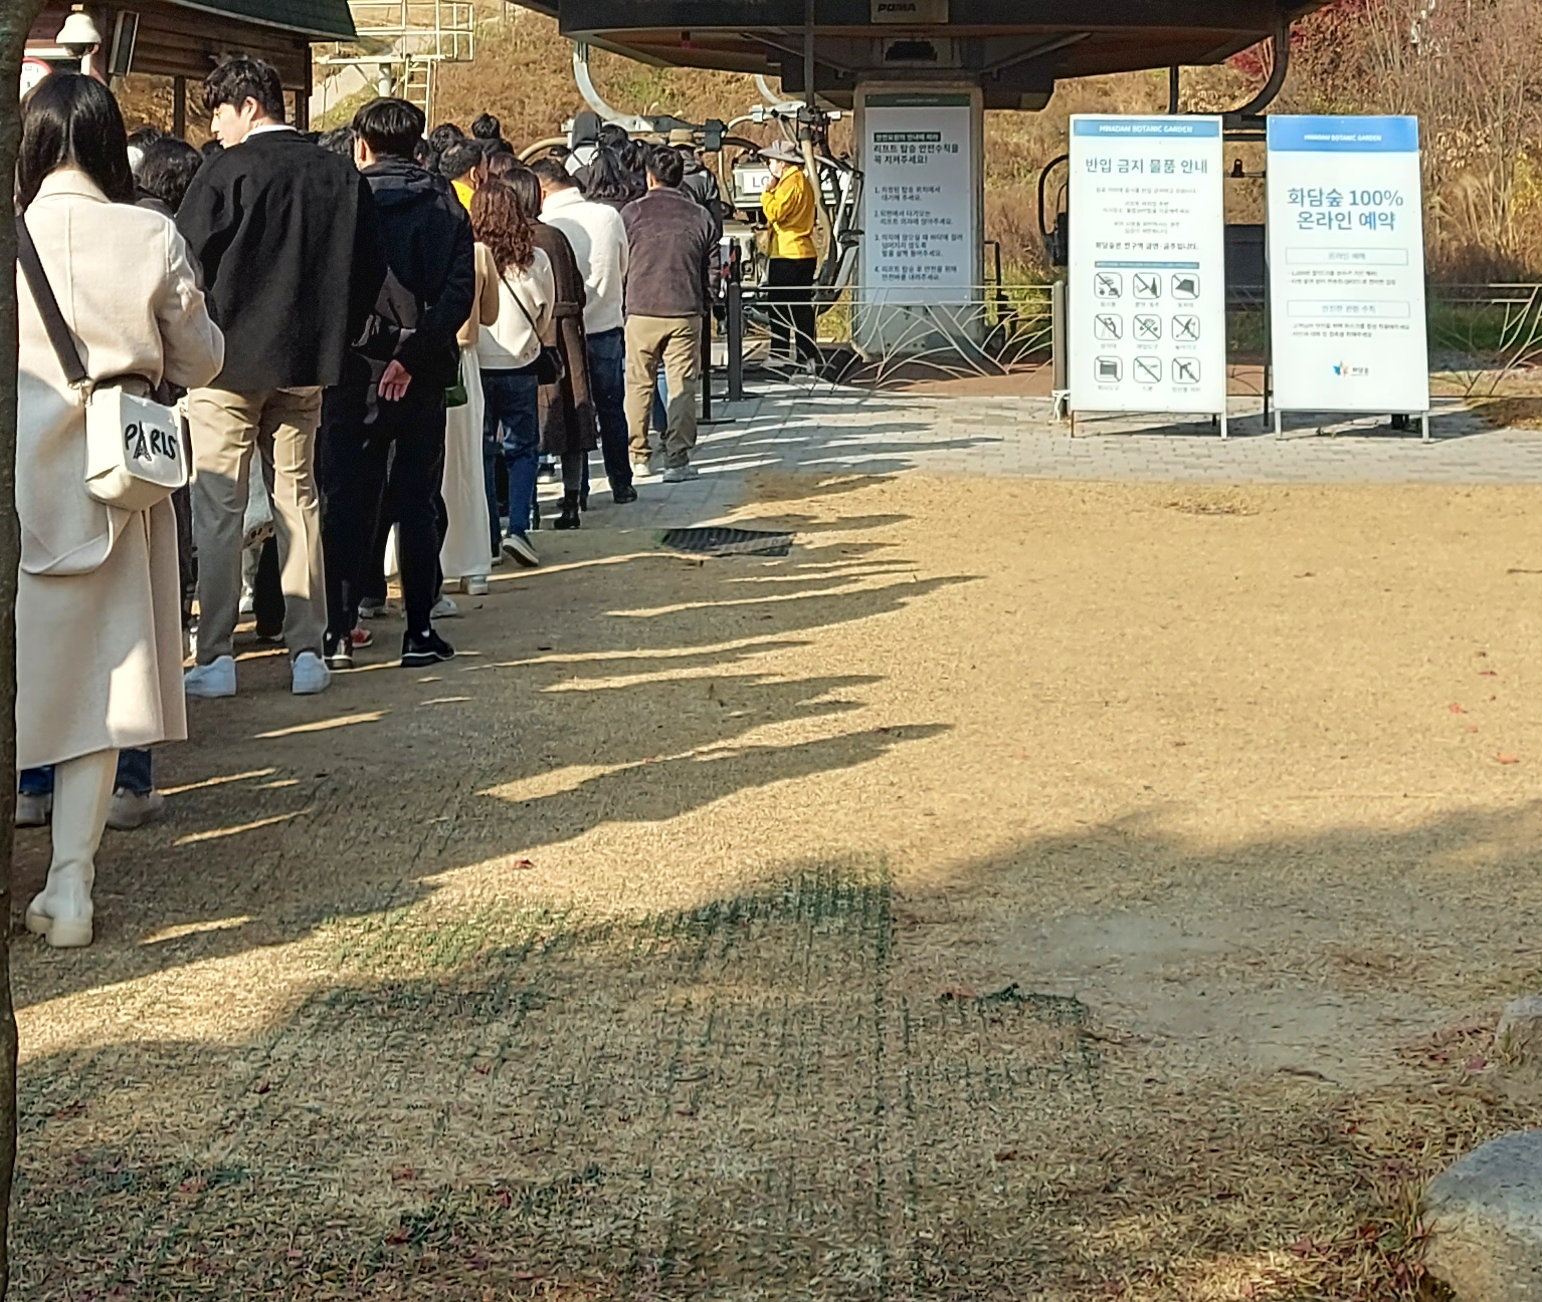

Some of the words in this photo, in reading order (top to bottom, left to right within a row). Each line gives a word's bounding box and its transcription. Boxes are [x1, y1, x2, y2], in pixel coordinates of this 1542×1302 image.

[1164, 125, 1193, 133] GARDEN
[874, 144, 898, 153] 리프트
[1085, 157, 1112, 173] 반입
[1117, 158, 1144, 174] 금지
[1149, 158, 1176, 174] 물품
[1180, 158, 1208, 174] 안내
[1287, 187, 1344, 207] 화담숲
[1349, 189, 1404, 207] 100%
[1297, 211, 1352, 230] 온라인
[1359, 211, 1396, 231] 예약
[124, 420, 177, 461] PARIS
